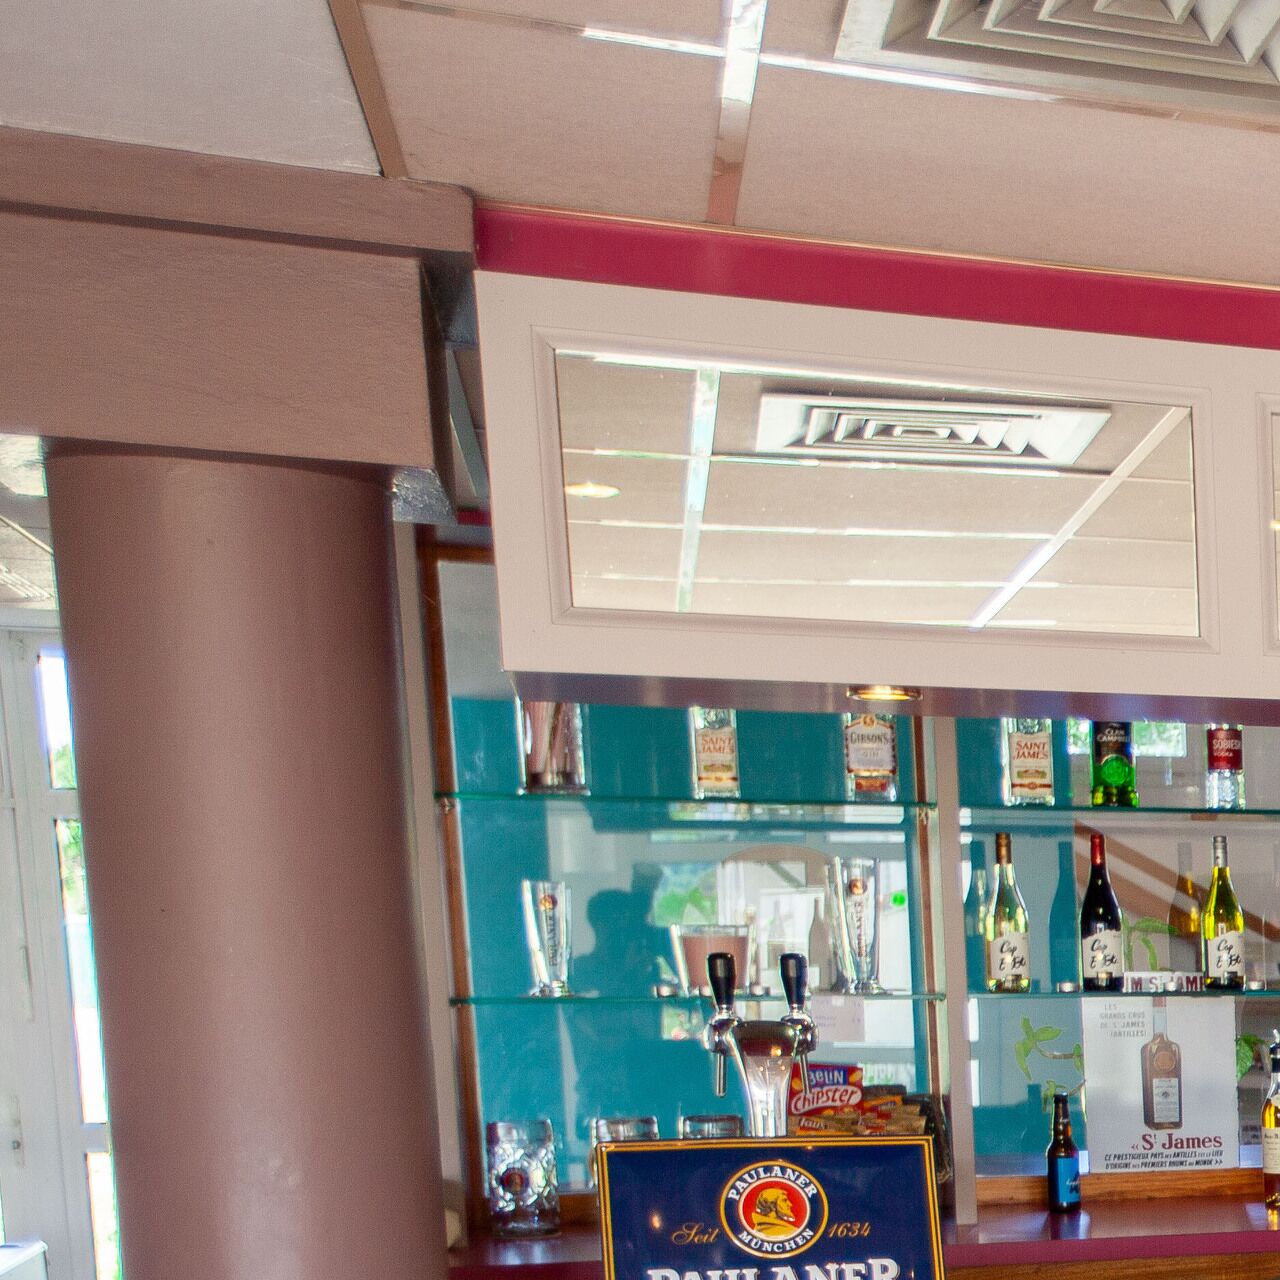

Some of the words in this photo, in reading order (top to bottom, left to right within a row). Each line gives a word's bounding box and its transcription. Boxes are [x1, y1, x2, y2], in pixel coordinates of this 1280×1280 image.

[702, 736, 733, 745] SAINT
[1016, 741, 1047, 751] SAINT
[1014, 750, 1049, 760] JAMES
[1161, 1133, 1223, 1150] James
[1172, 1150, 1197, 1159] ANTILLES
[728, 1166, 818, 1201] PAULANER
[672, 1222, 720, 1245] Seit
[827, 1221, 871, 1239] 1634
[739, 1228, 815, 1252] MÜNCHEN
